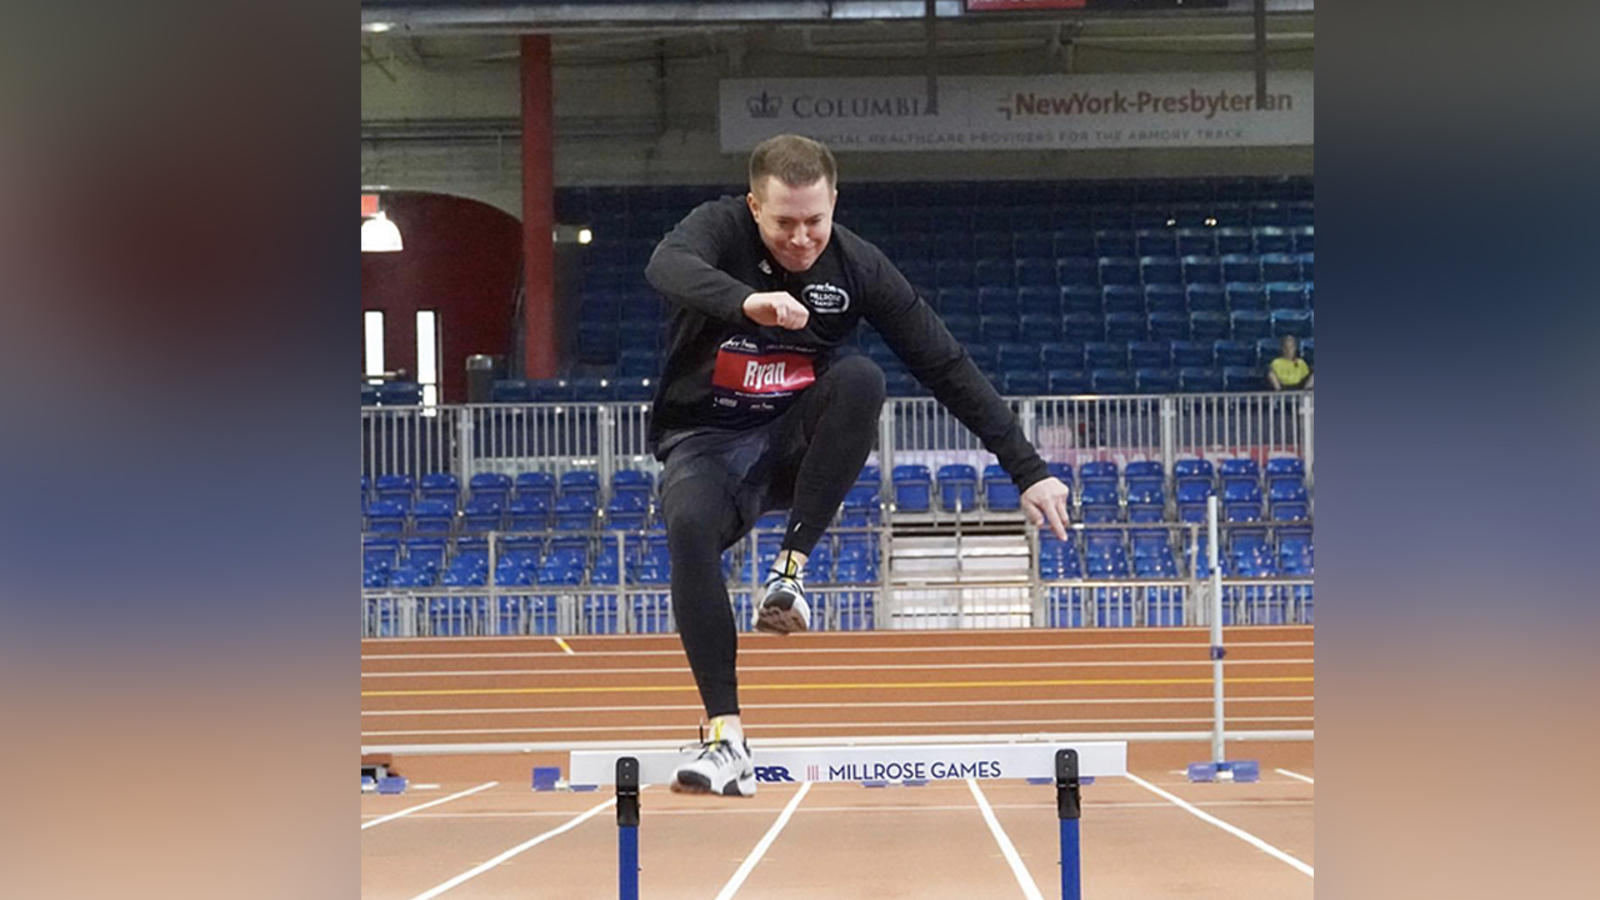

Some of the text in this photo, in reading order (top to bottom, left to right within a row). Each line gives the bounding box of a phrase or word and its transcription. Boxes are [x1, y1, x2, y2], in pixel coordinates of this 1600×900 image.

[1016, 89, 1293, 119] NewYork-Presbyteran
[868, 133, 964, 144] HEALTHCARE
[970, 132, 1054, 143] PROVIDERS
[1059, 130, 1088, 142] FOR
[1095, 130, 1123, 141] THE
[1128, 129, 1190, 140] ARMORY
[1197, 128, 1244, 139] TRACK
[743, 361, 786, 390] Ryan
[828, 762, 926, 780] MILLROSE
[930, 761, 1001, 779] GAMES
